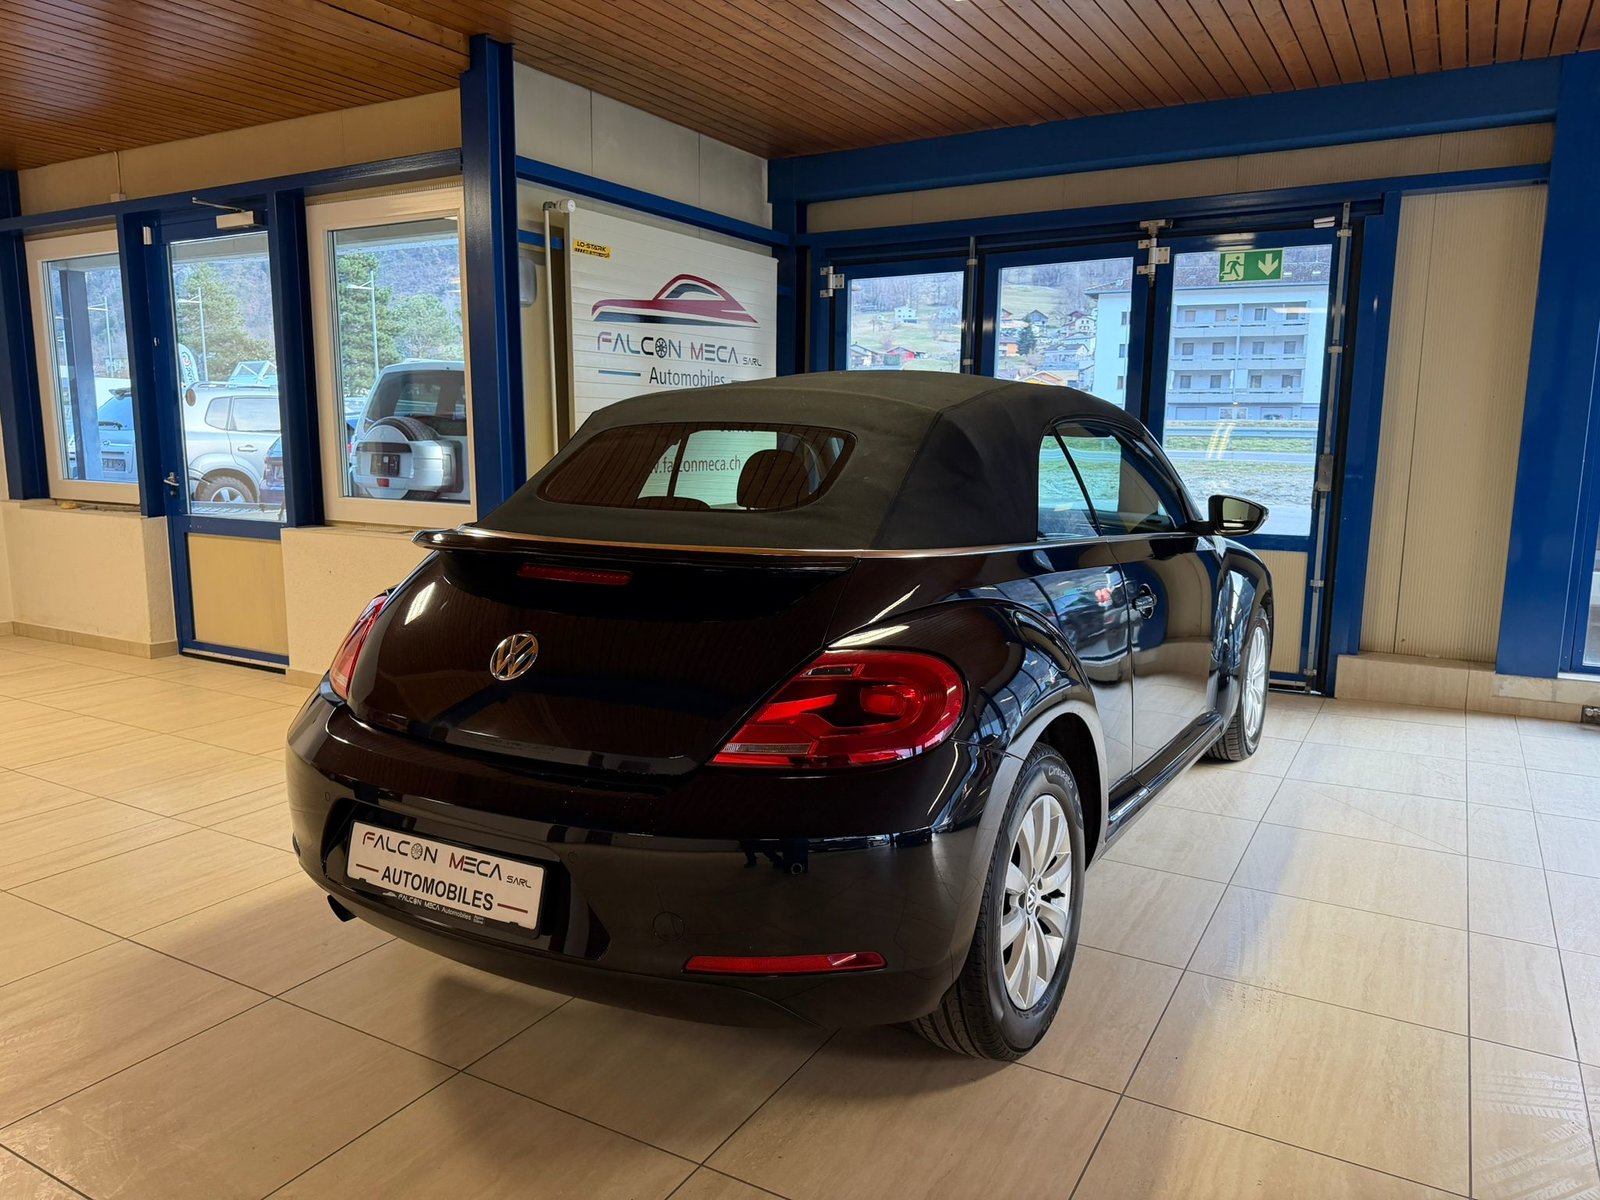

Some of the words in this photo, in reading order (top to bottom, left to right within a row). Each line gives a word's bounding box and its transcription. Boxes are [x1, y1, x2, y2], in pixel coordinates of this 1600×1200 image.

[597, 331, 681, 358] FALCON
[690, 342, 738, 364] MECA
[743, 357, 762, 366] SARL
[649, 366, 725, 387] Automobiles
[362, 831, 438, 864] FALCON
[449, 852, 502, 881] MECA
[506, 875, 532, 889] SARL
[381, 866, 494, 911] AUTOMOBILES
[398, 893, 422, 906] FALCON
[424, 901, 440, 911] MECA
[441, 906, 472, 921] Automobiles
